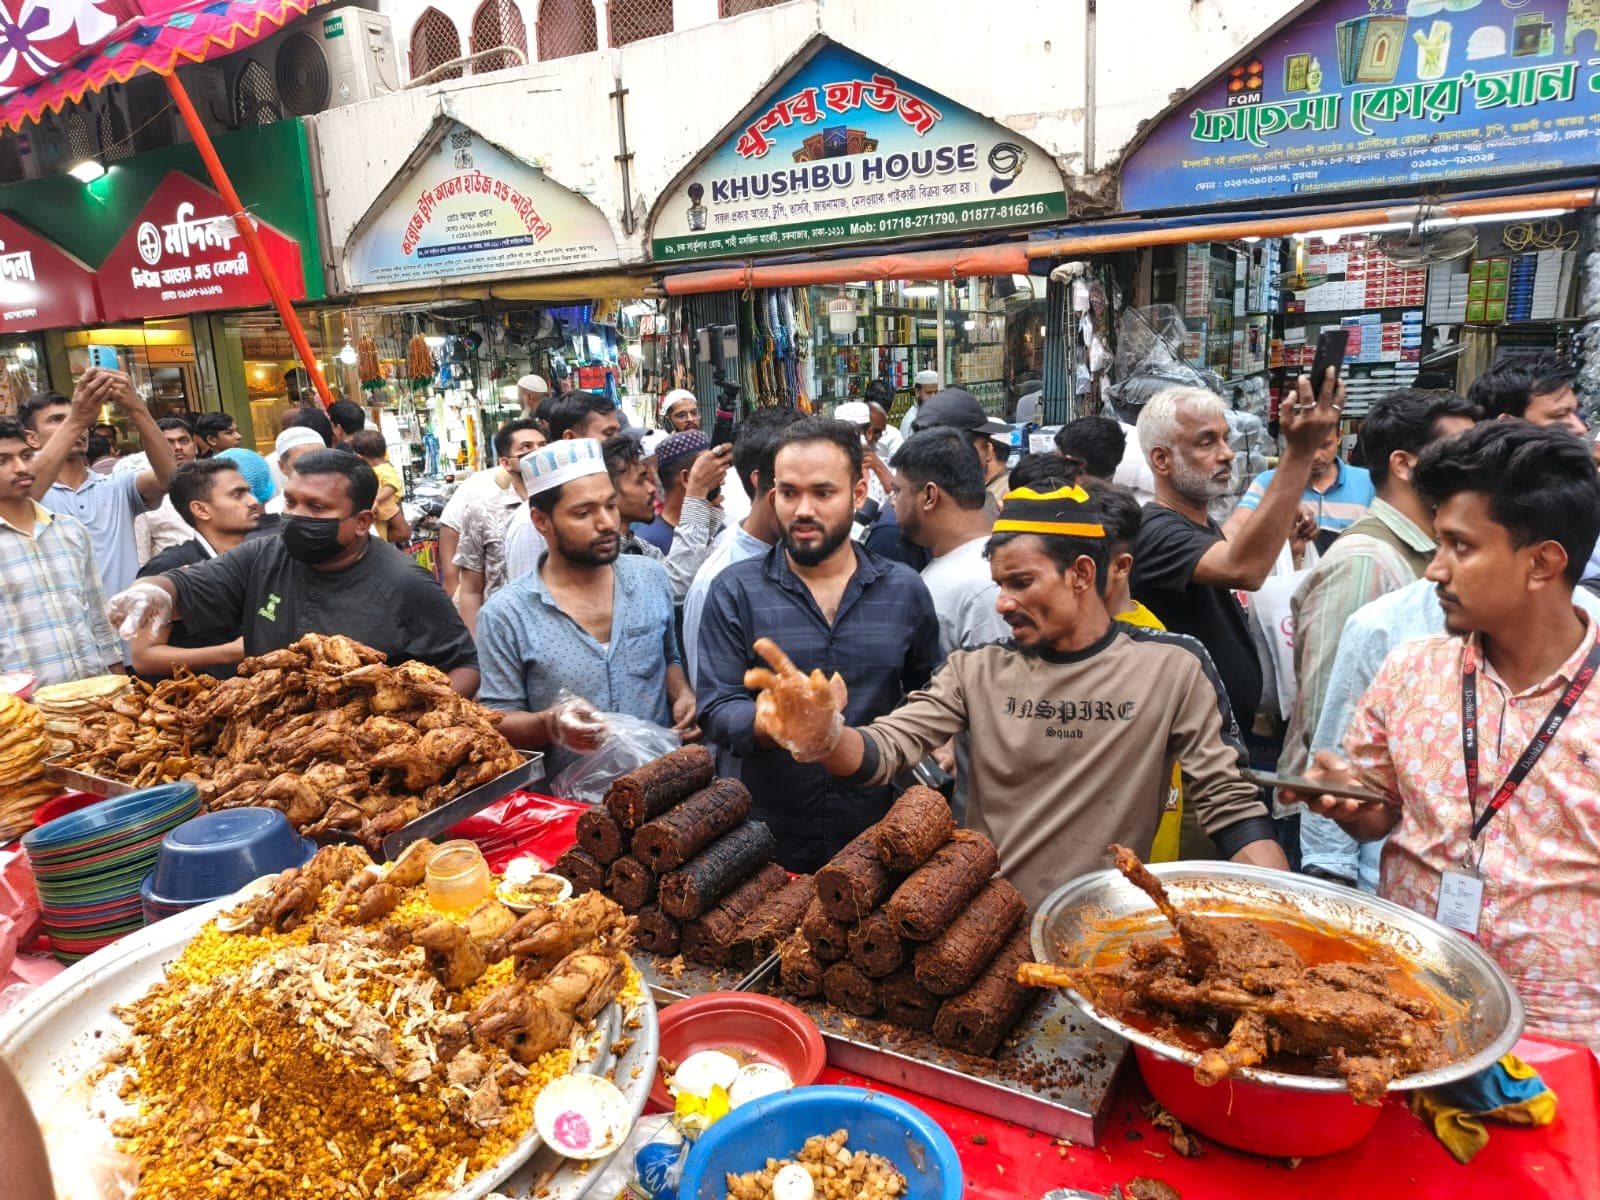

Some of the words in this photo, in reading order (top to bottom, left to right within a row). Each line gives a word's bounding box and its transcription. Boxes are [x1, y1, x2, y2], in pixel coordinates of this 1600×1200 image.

[735, 87, 824, 159] খুশবু
[826, 73, 942, 136] হাউজ
[1228, 93, 1261, 106] FQM
[1190, 94, 1341, 147] ফাতেমা
[711, 161, 853, 202] KHUSHBU
[861, 143, 976, 185] HOUSE
[942, 183, 957, 196] করা
[417, 188, 437, 223] টুপি
[433, 176, 462, 201] আতর
[463, 170, 493, 195] হাউজ
[494, 180, 512, 201] এন্ড
[161, 201, 231, 257] মদিনা
[850, 222, 876, 235] Mob:
[879, 211, 958, 232] 01718-271790,
[961, 202, 1044, 221] 01877-816216
[0, 239, 35, 281] দিনা
[213, 251, 249, 277] বেকারী
[1002, 696, 1136, 724] INSPIRE
[1539, 716, 1562, 742] News
[1563, 667, 1593, 707] PRESS
[1045, 726, 1083, 739] Squad
[1465, 719, 1475, 748] News
